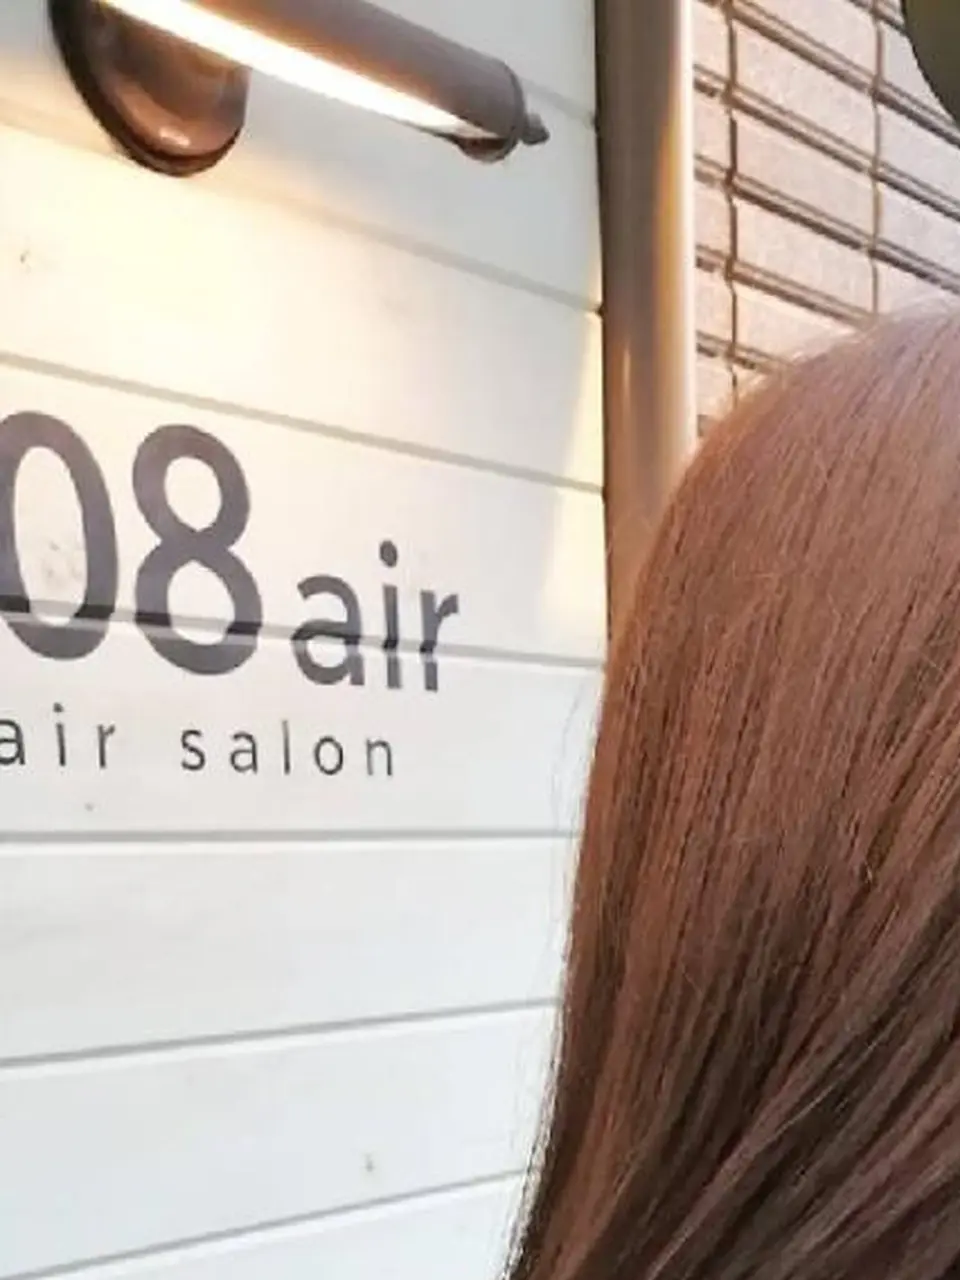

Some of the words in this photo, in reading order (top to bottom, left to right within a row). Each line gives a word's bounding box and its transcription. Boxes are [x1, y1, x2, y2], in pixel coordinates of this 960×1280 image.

[0, 411, 263, 676] 08
[292, 540, 459, 692] air
[180, 720, 394, 776] salon
